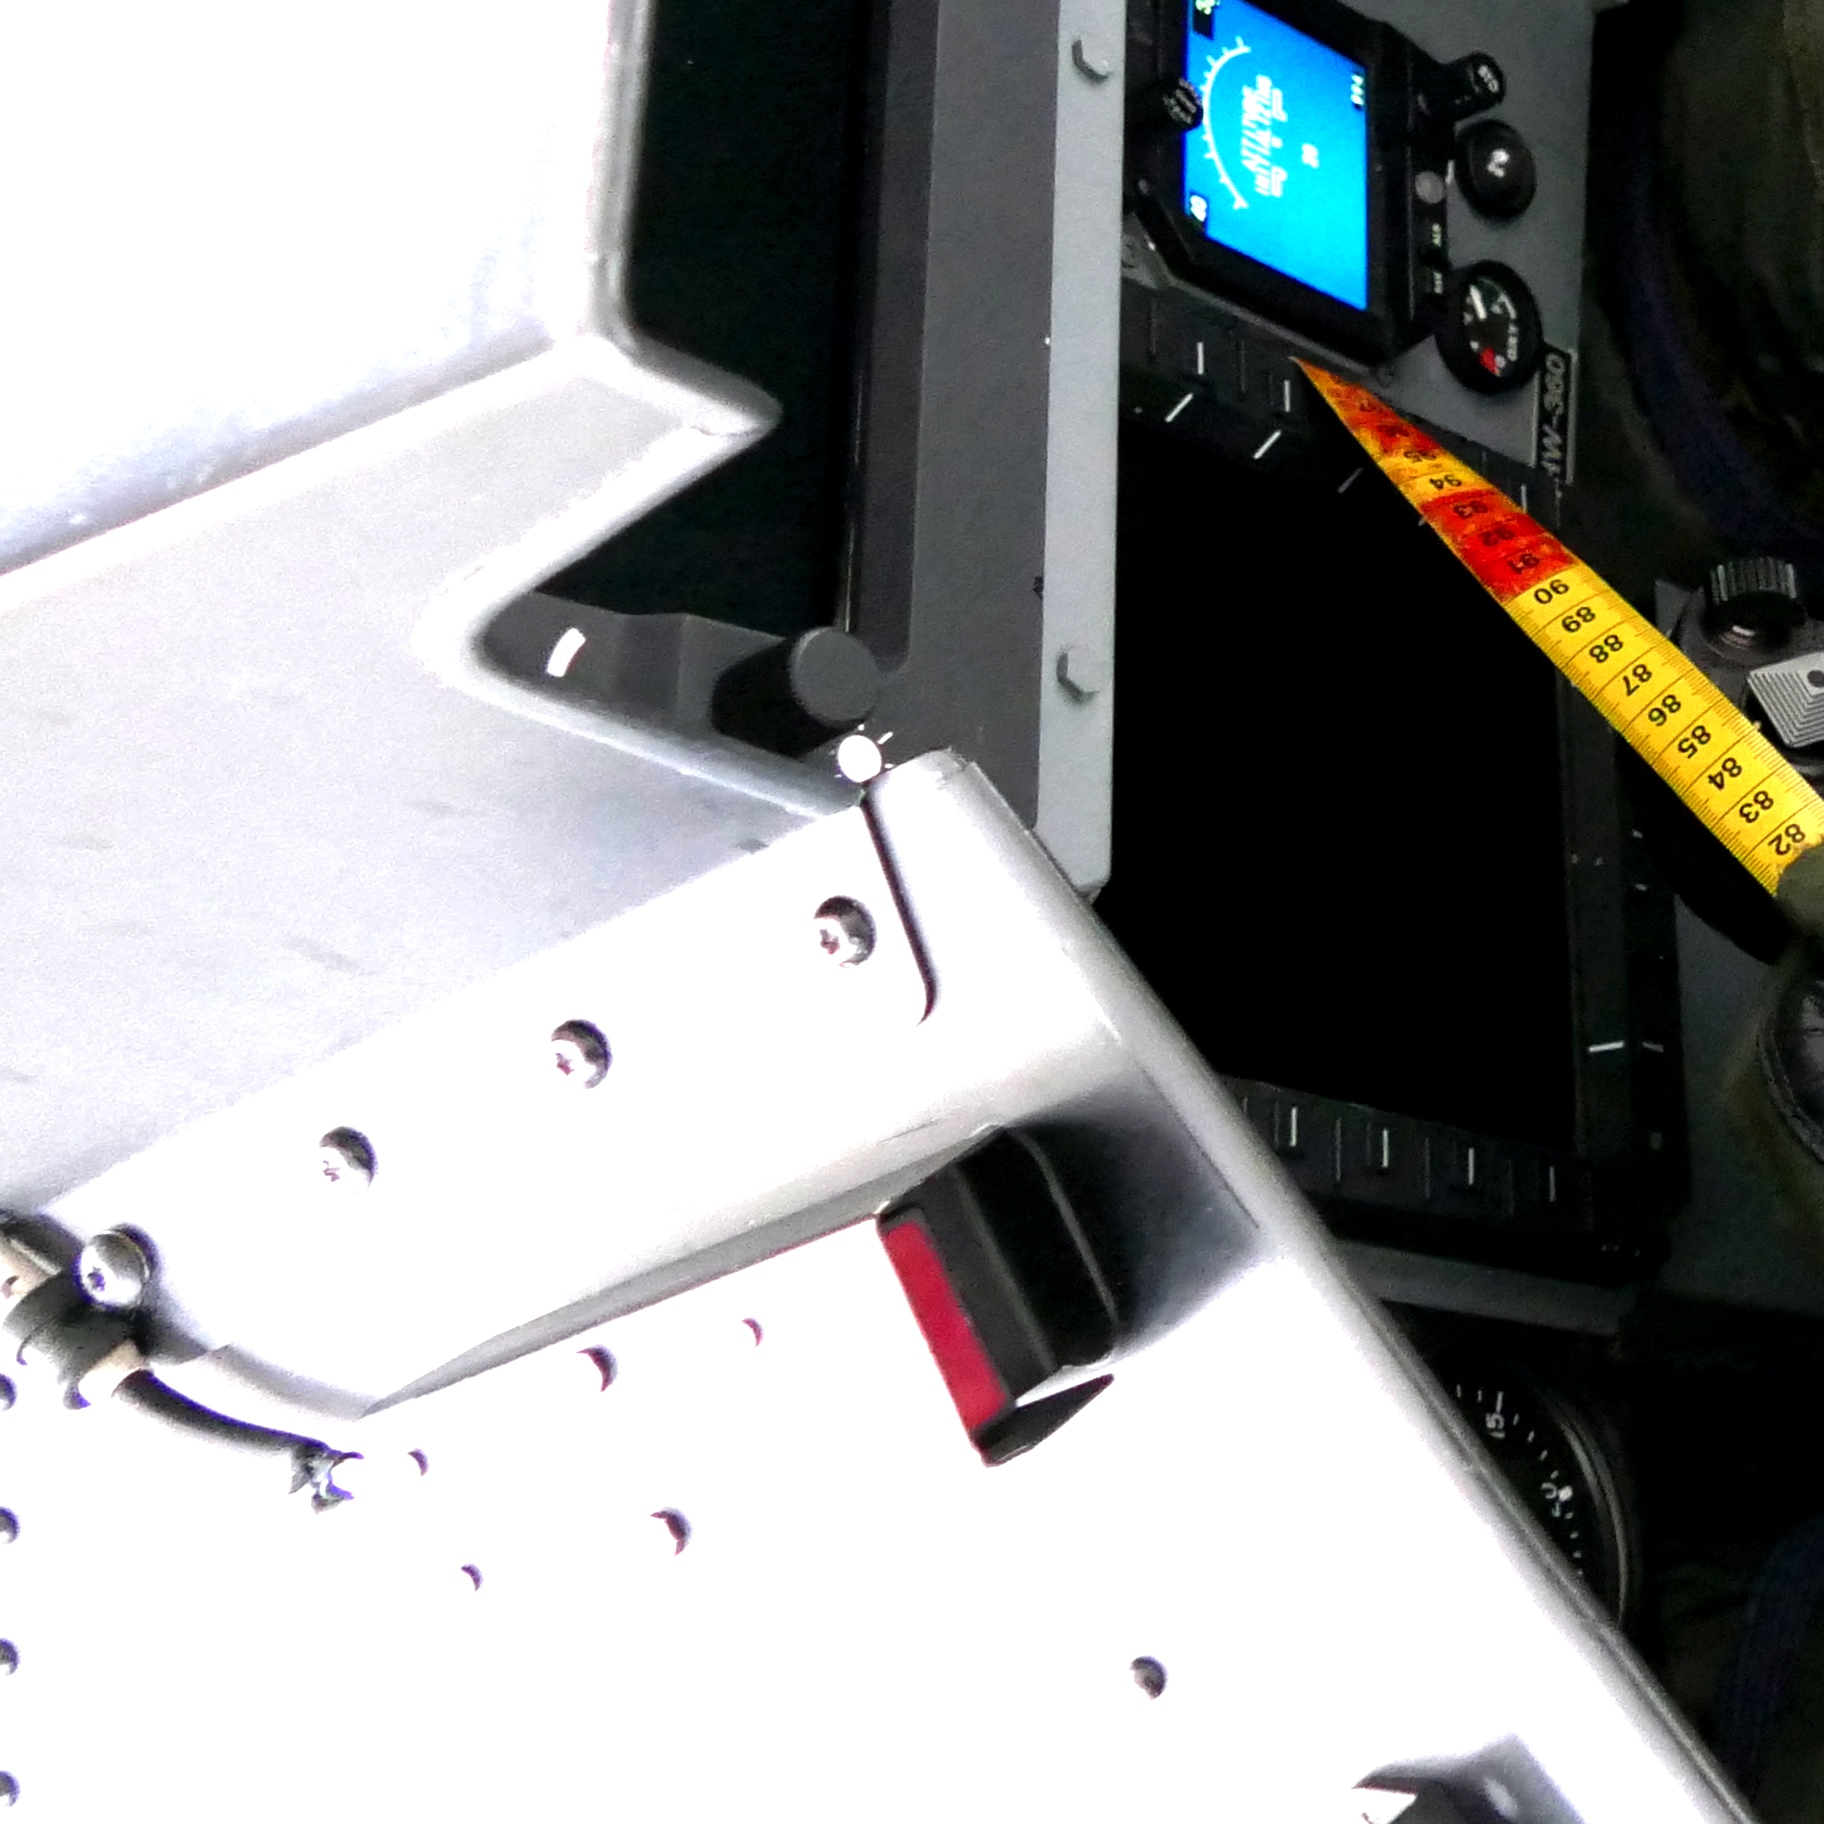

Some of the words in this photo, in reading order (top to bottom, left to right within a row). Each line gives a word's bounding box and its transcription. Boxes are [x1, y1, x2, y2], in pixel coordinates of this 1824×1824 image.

[1429, 474, 1462, 491] 94
[1456, 500, 1489, 518] 93
[1482, 527, 1515, 547] 92
[1506, 553, 1540, 573] 91
[1532, 578, 1570, 606] 90
[1559, 605, 1597, 635] 89
[1588, 633, 1625, 663] 88
[1621, 662, 1653, 698] 87
[1646, 693, 1682, 728] 86
[1676, 725, 1713, 760] 85
[1707, 756, 1743, 792] 84
[1737, 788, 1775, 825] 83
[1767, 821, 1807, 857] 82
[1486, 1413, 1505, 1438] 15
